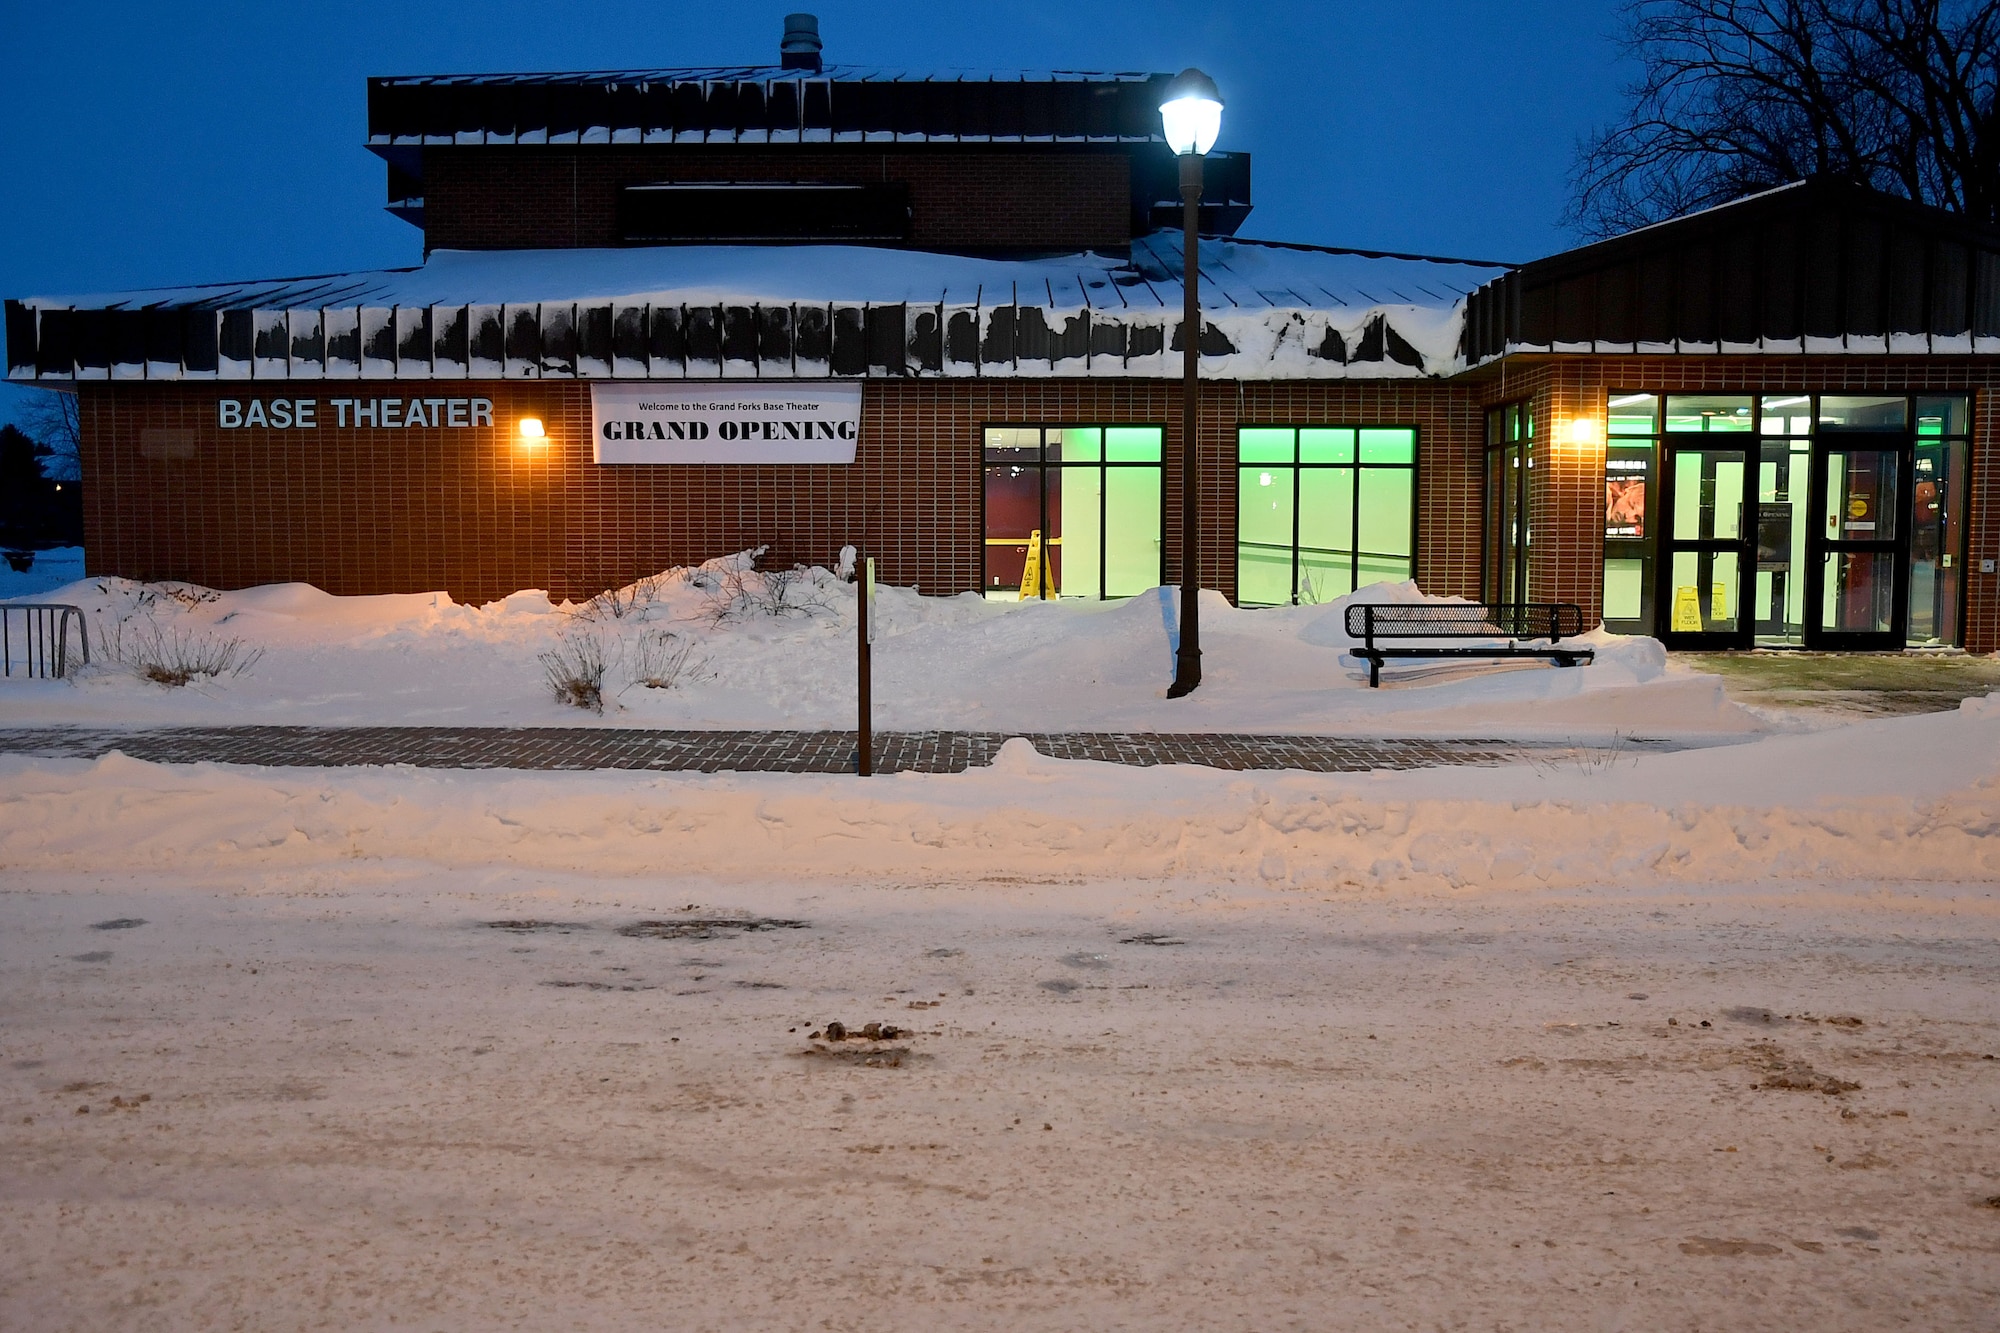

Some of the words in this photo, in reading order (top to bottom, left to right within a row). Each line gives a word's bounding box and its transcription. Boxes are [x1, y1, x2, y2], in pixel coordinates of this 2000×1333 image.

[219, 399, 317, 429] BASE
[330, 398, 495, 428] THEATER
[638, 402, 680, 411] Welcome
[681, 403, 691, 411] to
[692, 402, 707, 411] the
[709, 402, 736, 411] Grand
[737, 402, 761, 411] Forks
[763, 402, 784, 411] Base
[786, 402, 820, 411] Theater
[602, 420, 709, 441] GRAND
[718, 420, 856, 441] OPENING
